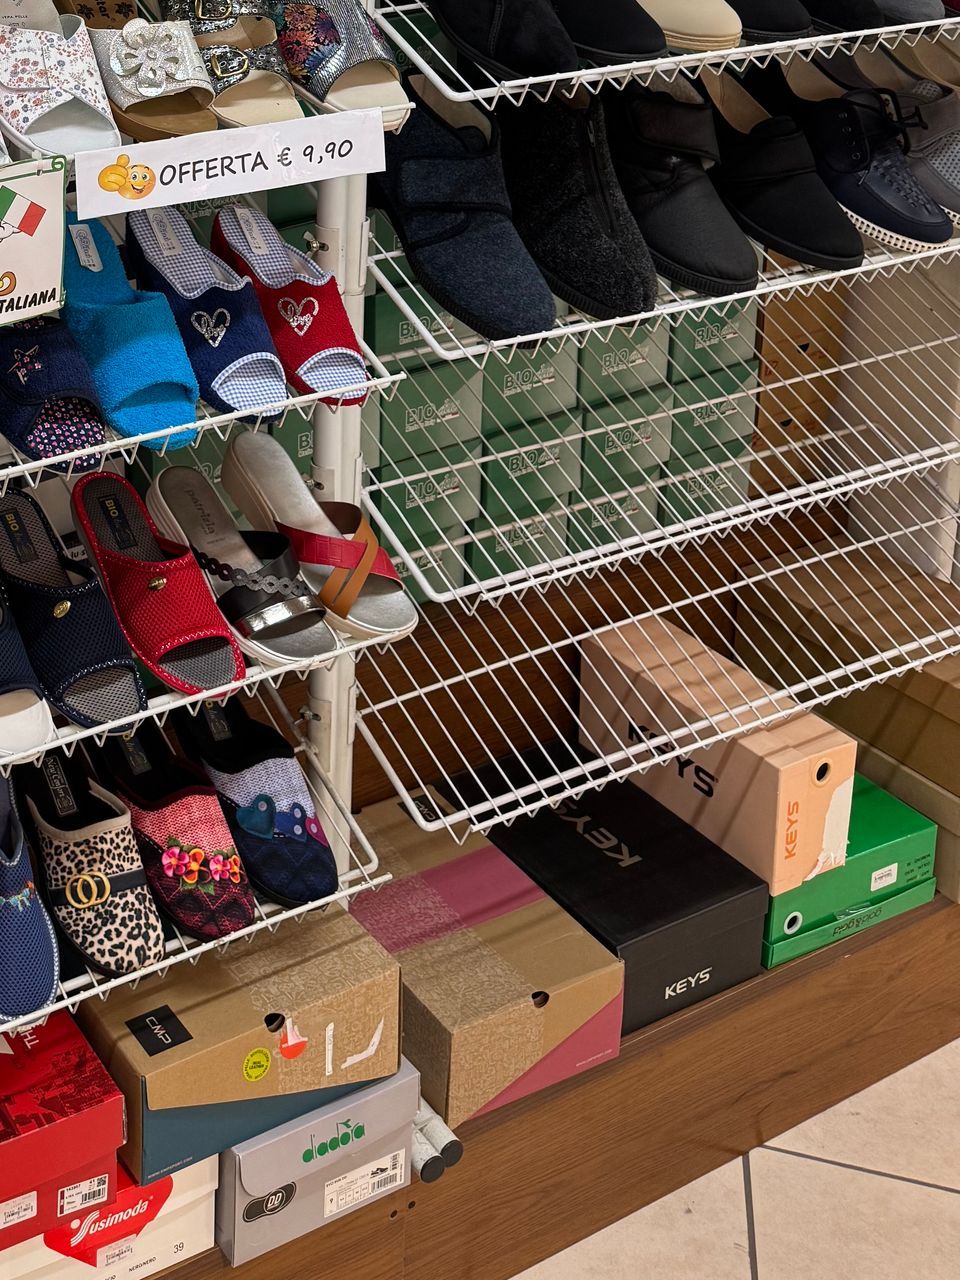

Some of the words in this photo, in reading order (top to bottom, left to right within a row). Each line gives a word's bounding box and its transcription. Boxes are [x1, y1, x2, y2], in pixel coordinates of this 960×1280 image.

[159, 150, 269, 186] OFFERTA
[276, 147, 292, 167] €
[302, 138, 354, 165] 9,90
[5, 512, 19, 532] BIO
[105, 499, 119, 518] BIO
[185, 486, 216, 535] patrizia
[784, 800, 800, 860] KEYS
[664, 966, 713, 1000] KEYS
[146, 1016, 172, 1045] CMP
[301, 1118, 365, 1164] diadora
[173, 1242, 185, 1253] 39
